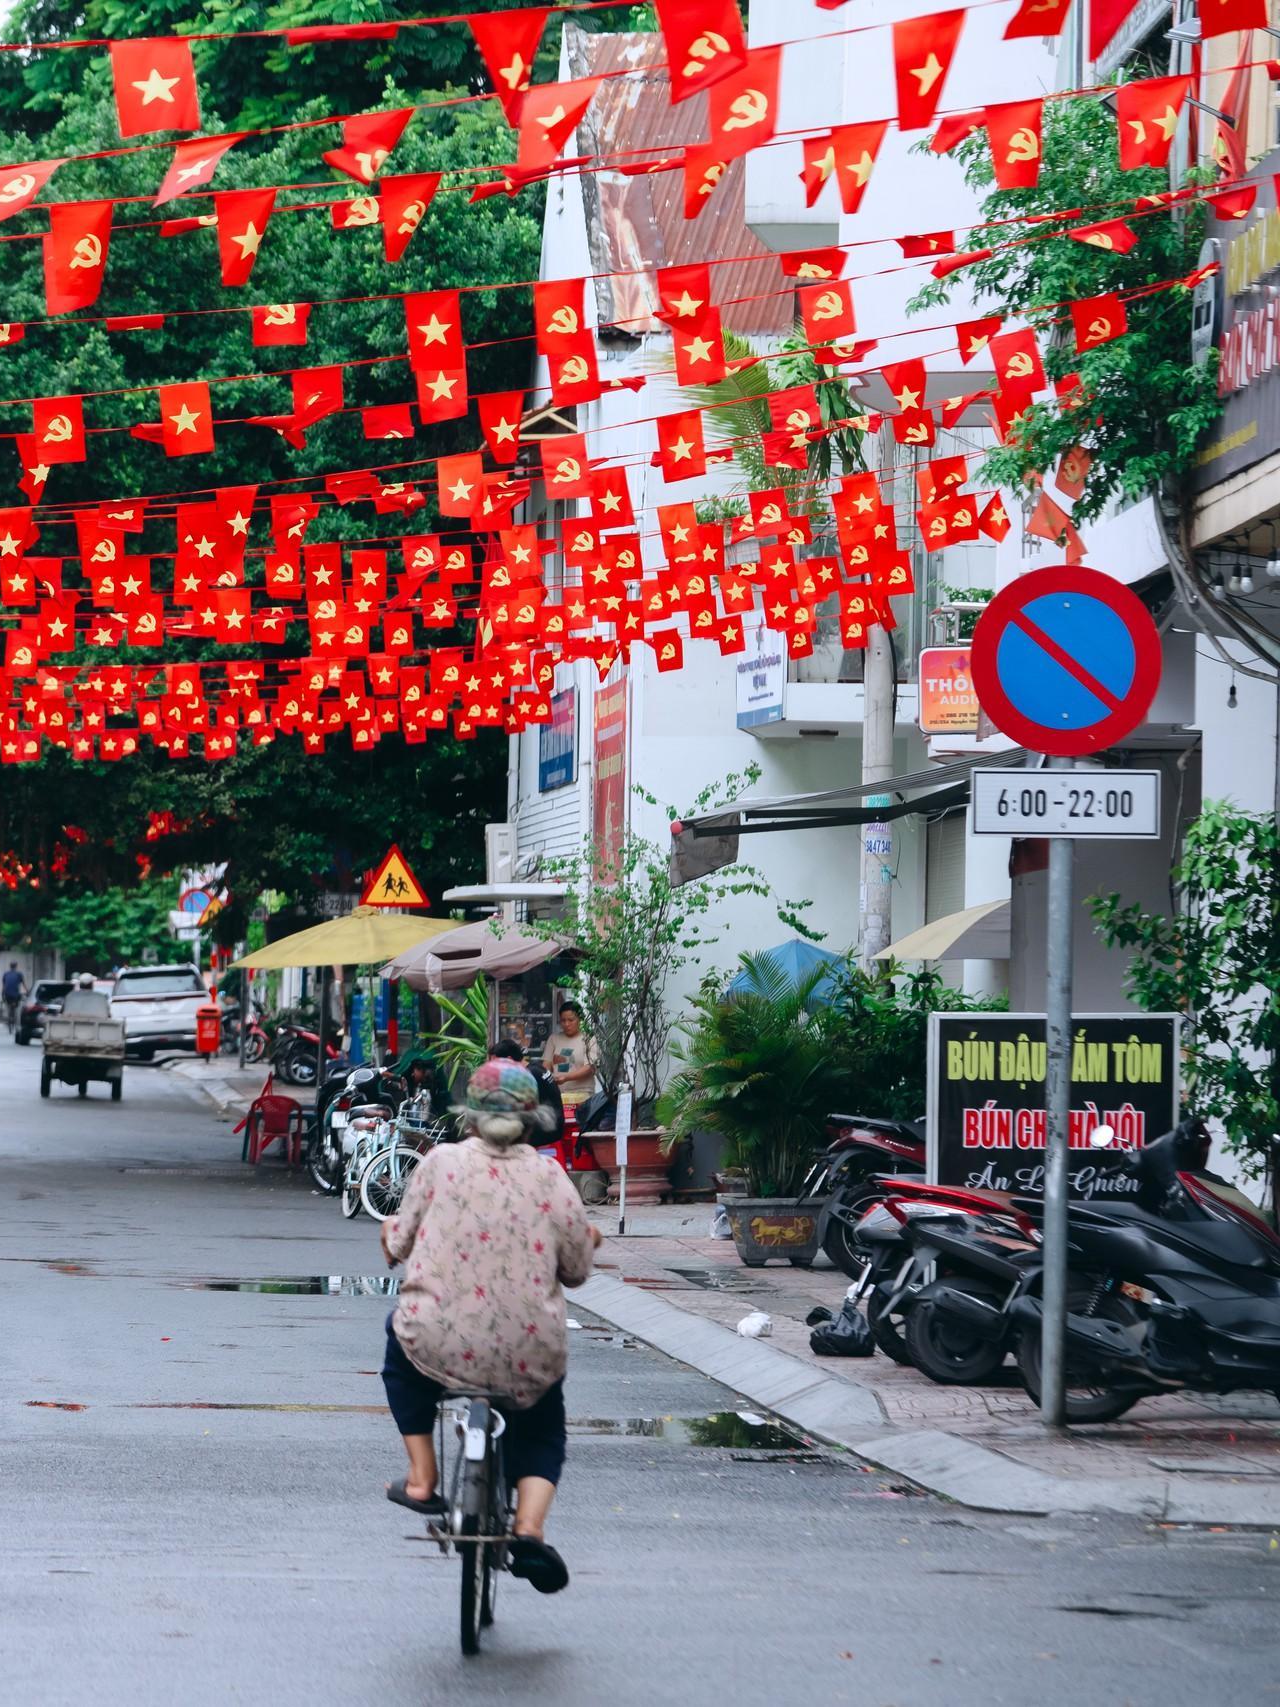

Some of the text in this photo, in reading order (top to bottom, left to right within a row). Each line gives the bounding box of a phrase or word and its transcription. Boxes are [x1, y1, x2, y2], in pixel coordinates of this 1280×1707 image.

[926, 674, 974, 693] THÔ
[946, 1028, 1162, 1090] BÚN ĐẬU ẮM TÔM
[963, 1100, 1012, 1149] BÚN
[1016, 1108, 1048, 1149] CH
[964, 1161, 1012, 1191] Ăn
[1015, 1165, 1046, 1192] L
